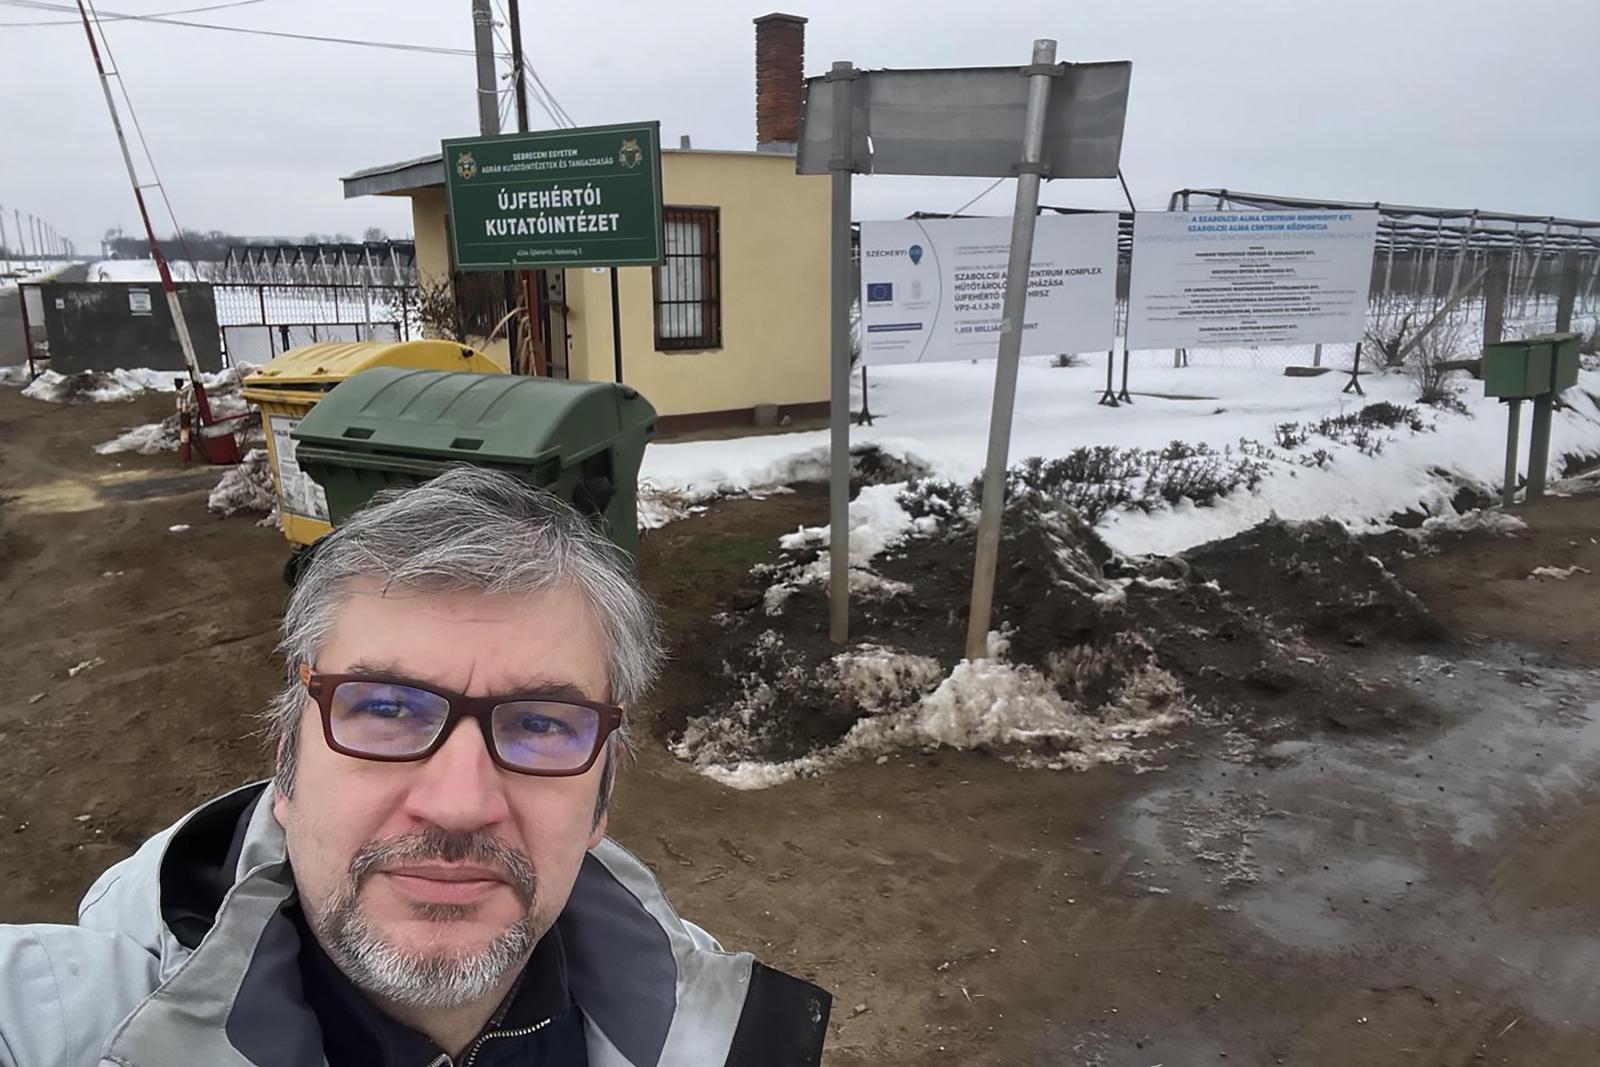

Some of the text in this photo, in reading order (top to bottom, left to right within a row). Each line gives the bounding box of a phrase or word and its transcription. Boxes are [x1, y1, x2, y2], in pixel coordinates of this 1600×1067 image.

[512, 149, 578, 161] DEBRECENI EGYETEM
[481, 156, 614, 173] AGRÁR KUTATÓINTÉZETEK ÉS TANGAZDASÁG
[498, 182, 601, 210] ÚJFEHÉRTÓI
[485, 210, 619, 236] KUTATÓINTÉZET
[1240, 214, 1260, 222] ALMA
[1261, 214, 1296, 222] CENTRUM
[1229, 224, 1249, 232] ALMA
[866, 248, 907, 257] SZÉCHENYI
[954, 272, 1000, 281] SZABOLCSI
[1029, 269, 1063, 278] ENTRUM
[1065, 267, 1102, 276] KOMPLEX
[954, 292, 1000, 301] ÚJFEHÉRTÓ
